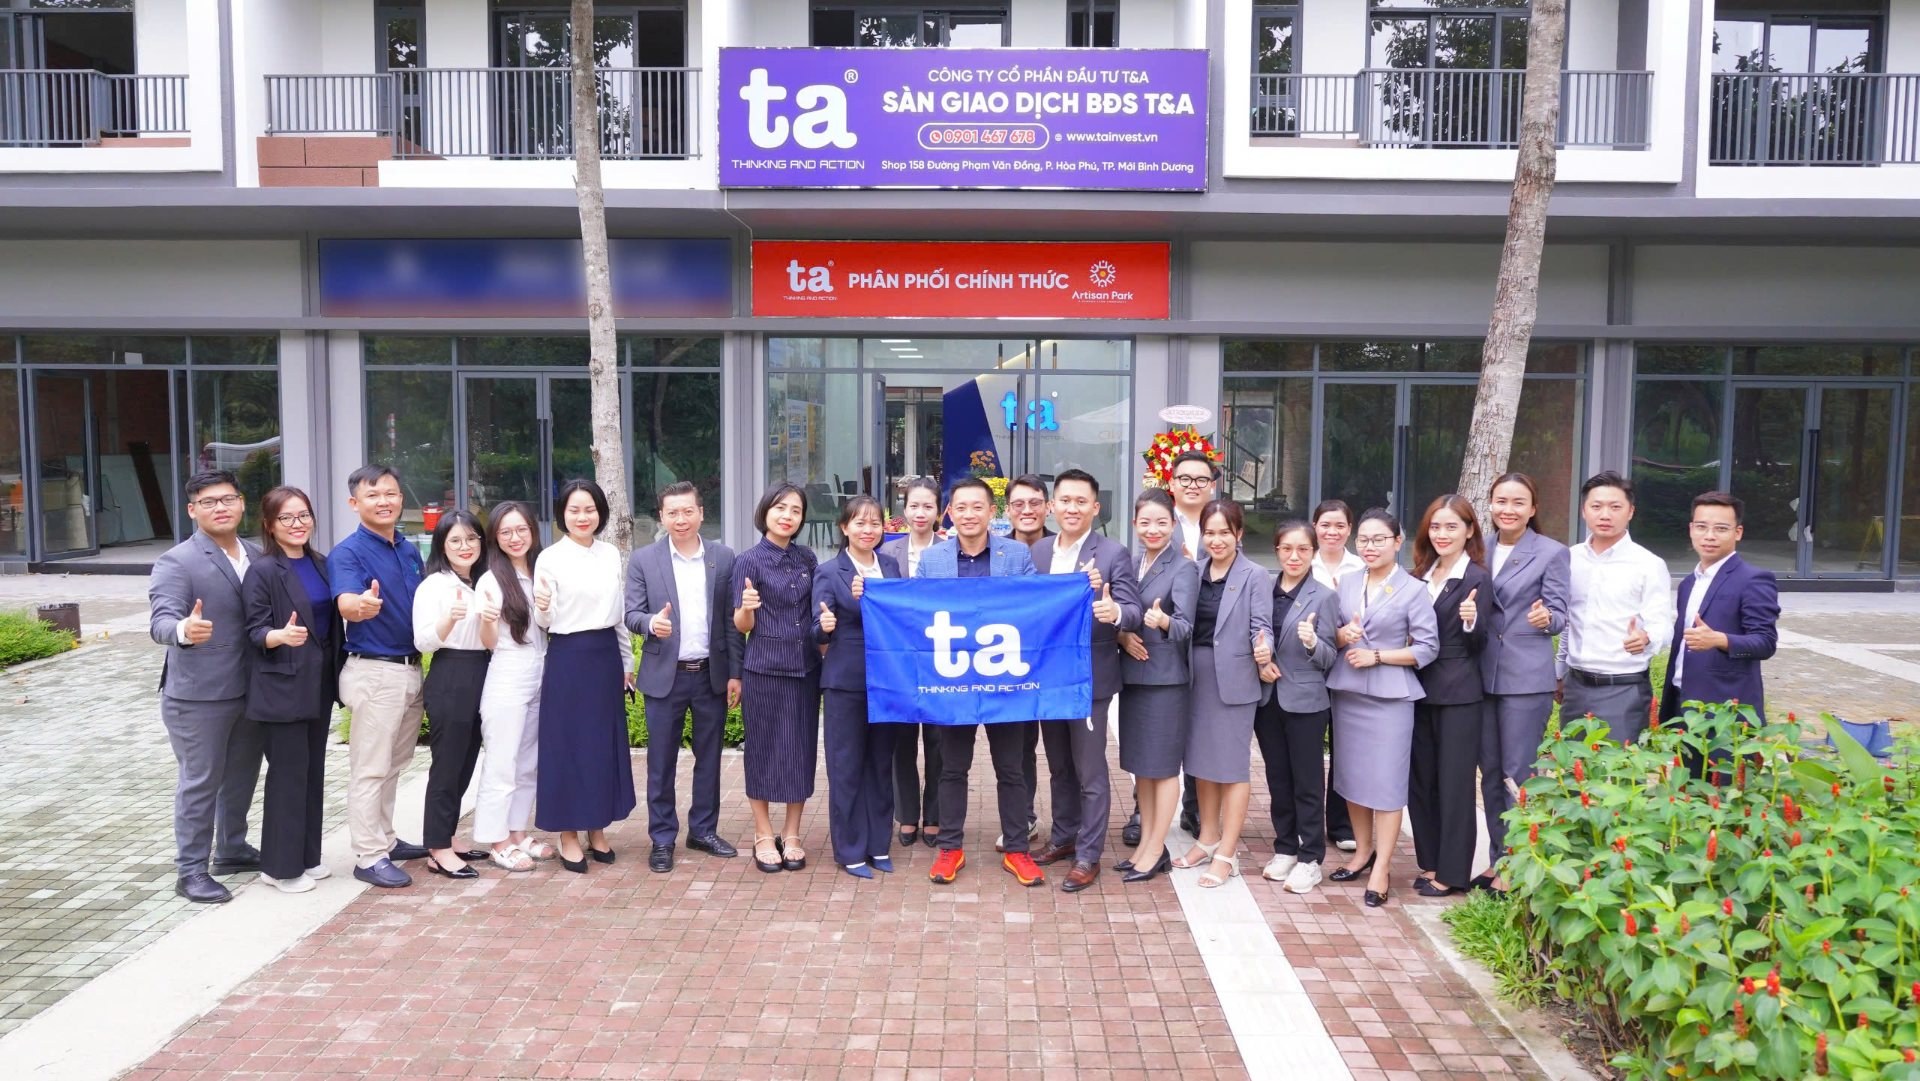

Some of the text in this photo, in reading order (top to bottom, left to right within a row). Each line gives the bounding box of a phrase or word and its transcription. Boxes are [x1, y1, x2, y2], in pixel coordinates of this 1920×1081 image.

[928, 66, 973, 83] CÔNG
[976, 69, 994, 83] TY
[997, 65, 1021, 83] CỔ
[1100, 69, 1120, 83] TƯ
[1122, 70, 1150, 84] T&A
[882, 85, 1195, 120] SÀN GIAO DỊCH BĐS T&A
[943, 129, 1036, 144] 0901 467 678
[1066, 131, 1158, 143] www.tainvest.vn
[731, 159, 866, 170] THINKING AND ACTION
[881, 160, 907, 171] Shop
[909, 160, 925, 170] 158
[927, 159, 960, 172] Đường
[962, 160, 990, 172] Phạm
[992, 160, 1012, 170] Văn
[1045, 161, 1053, 171] P.
[1056, 160, 1076, 171] Hòa
[1102, 162, 1116, 171] TP.
[1138, 162, 1159, 172] Bình
[1161, 162, 1194, 174] Dương
[786, 259, 834, 293] ta
[848, 268, 1069, 290] PHÂN PHỐI CHÍNH THỨC
[1072, 290, 1134, 300] Artisan Park
[1000, 391, 1059, 432] ta
[924, 610, 1031, 678] ta
[918, 682, 1040, 694] THINKING AND ACTION
